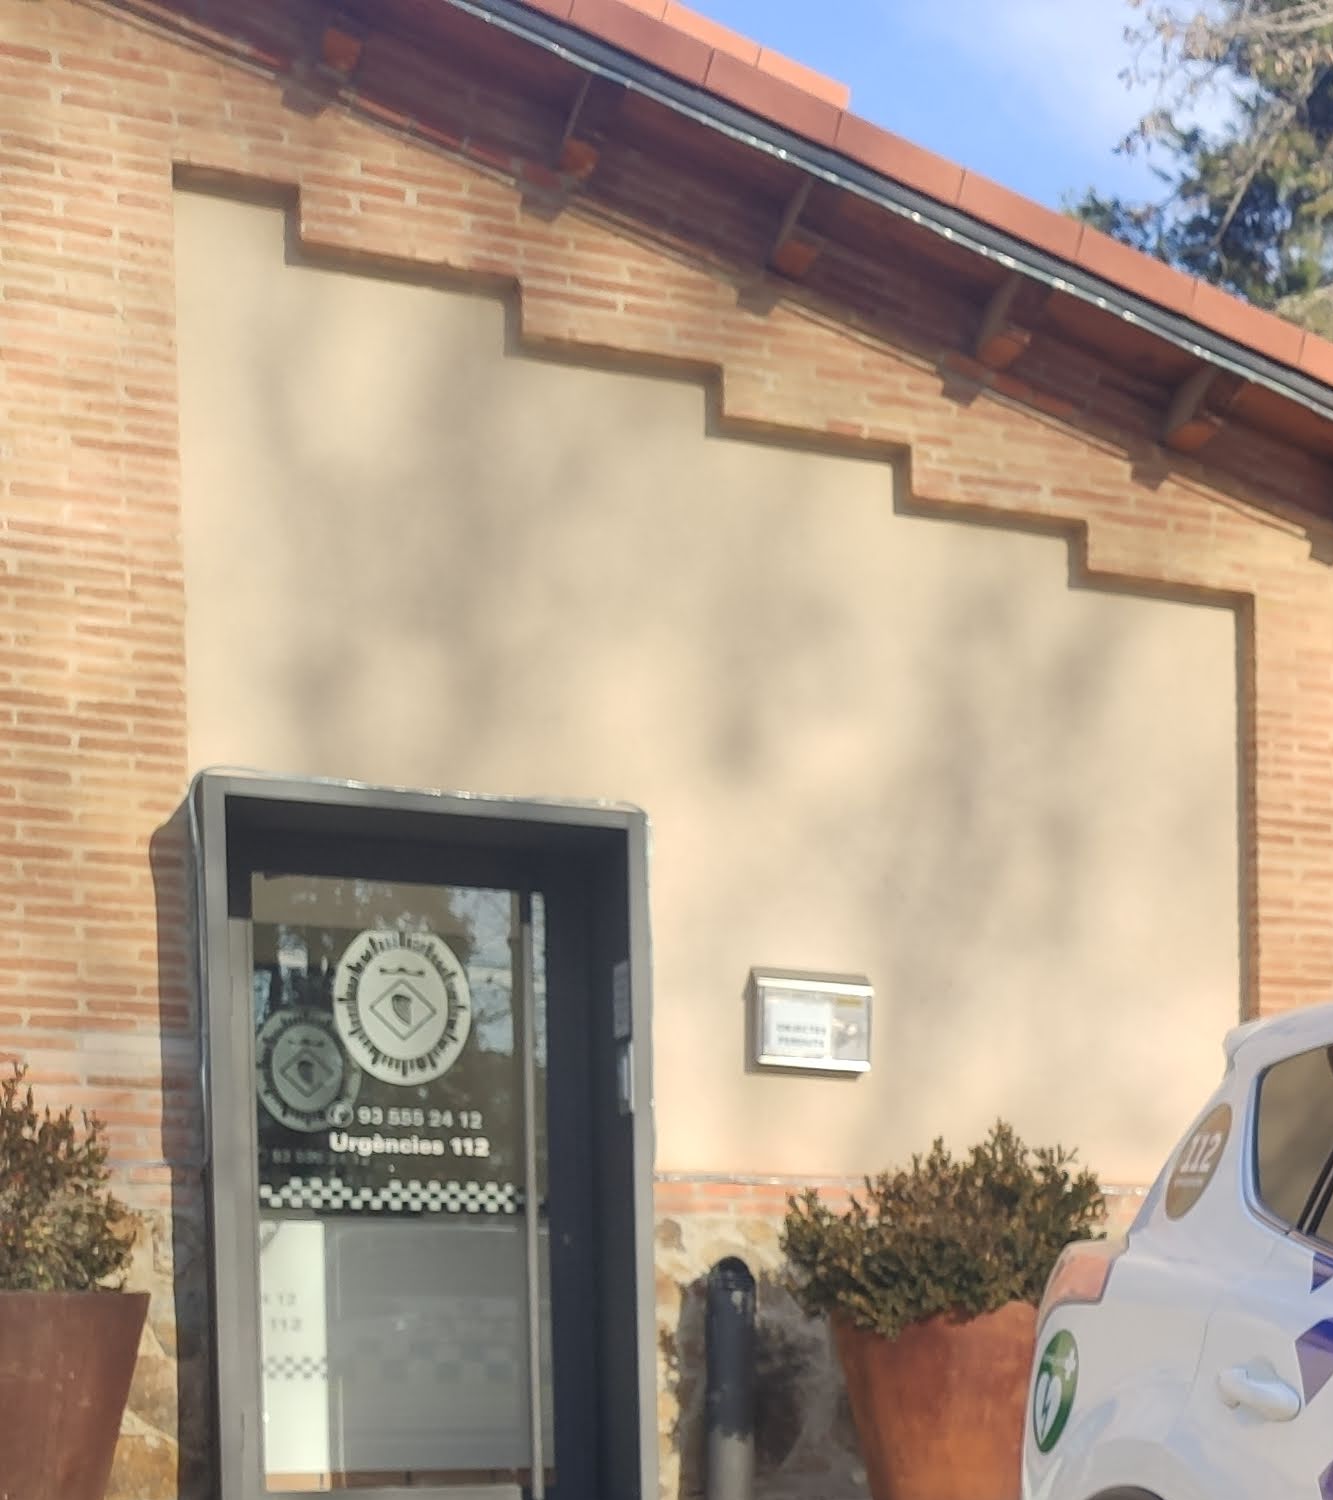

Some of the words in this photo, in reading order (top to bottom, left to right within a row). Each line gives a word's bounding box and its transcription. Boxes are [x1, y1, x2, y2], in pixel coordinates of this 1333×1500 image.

[459, 1110, 483, 1129] 12
[450, 1137, 490, 1157] 112
[1180, 1133, 1222, 1172] 112
